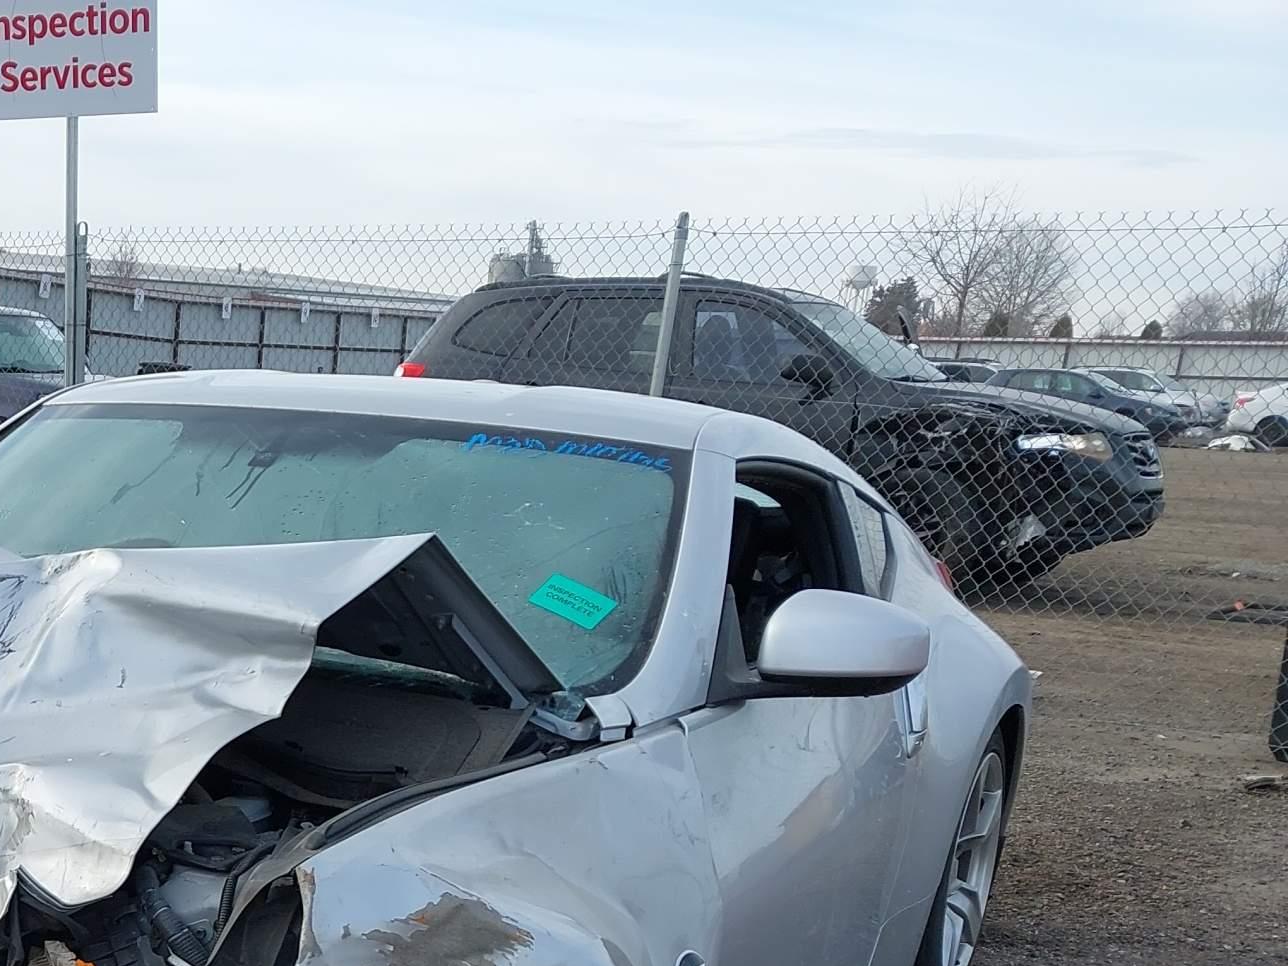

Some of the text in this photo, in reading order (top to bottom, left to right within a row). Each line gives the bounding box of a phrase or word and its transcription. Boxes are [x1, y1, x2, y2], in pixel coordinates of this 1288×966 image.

[0, 57, 133, 93] Services
[545, 591, 594, 617] COMPLETE
[548, 583, 602, 613] INSPECTION
